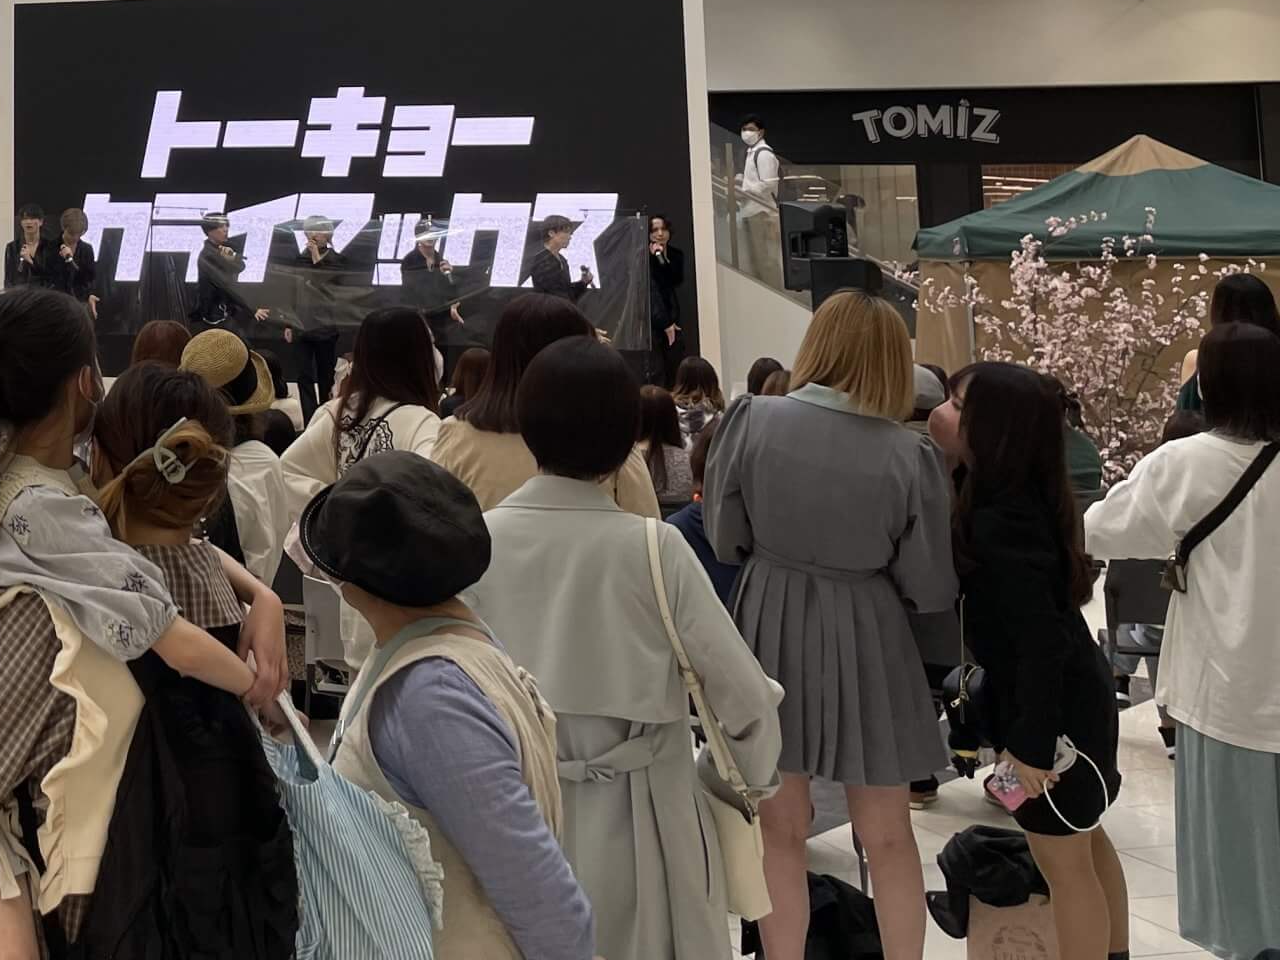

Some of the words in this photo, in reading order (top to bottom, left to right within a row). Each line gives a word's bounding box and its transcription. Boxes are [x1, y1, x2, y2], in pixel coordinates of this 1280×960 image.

[140, 86, 535, 178] トーキョー
